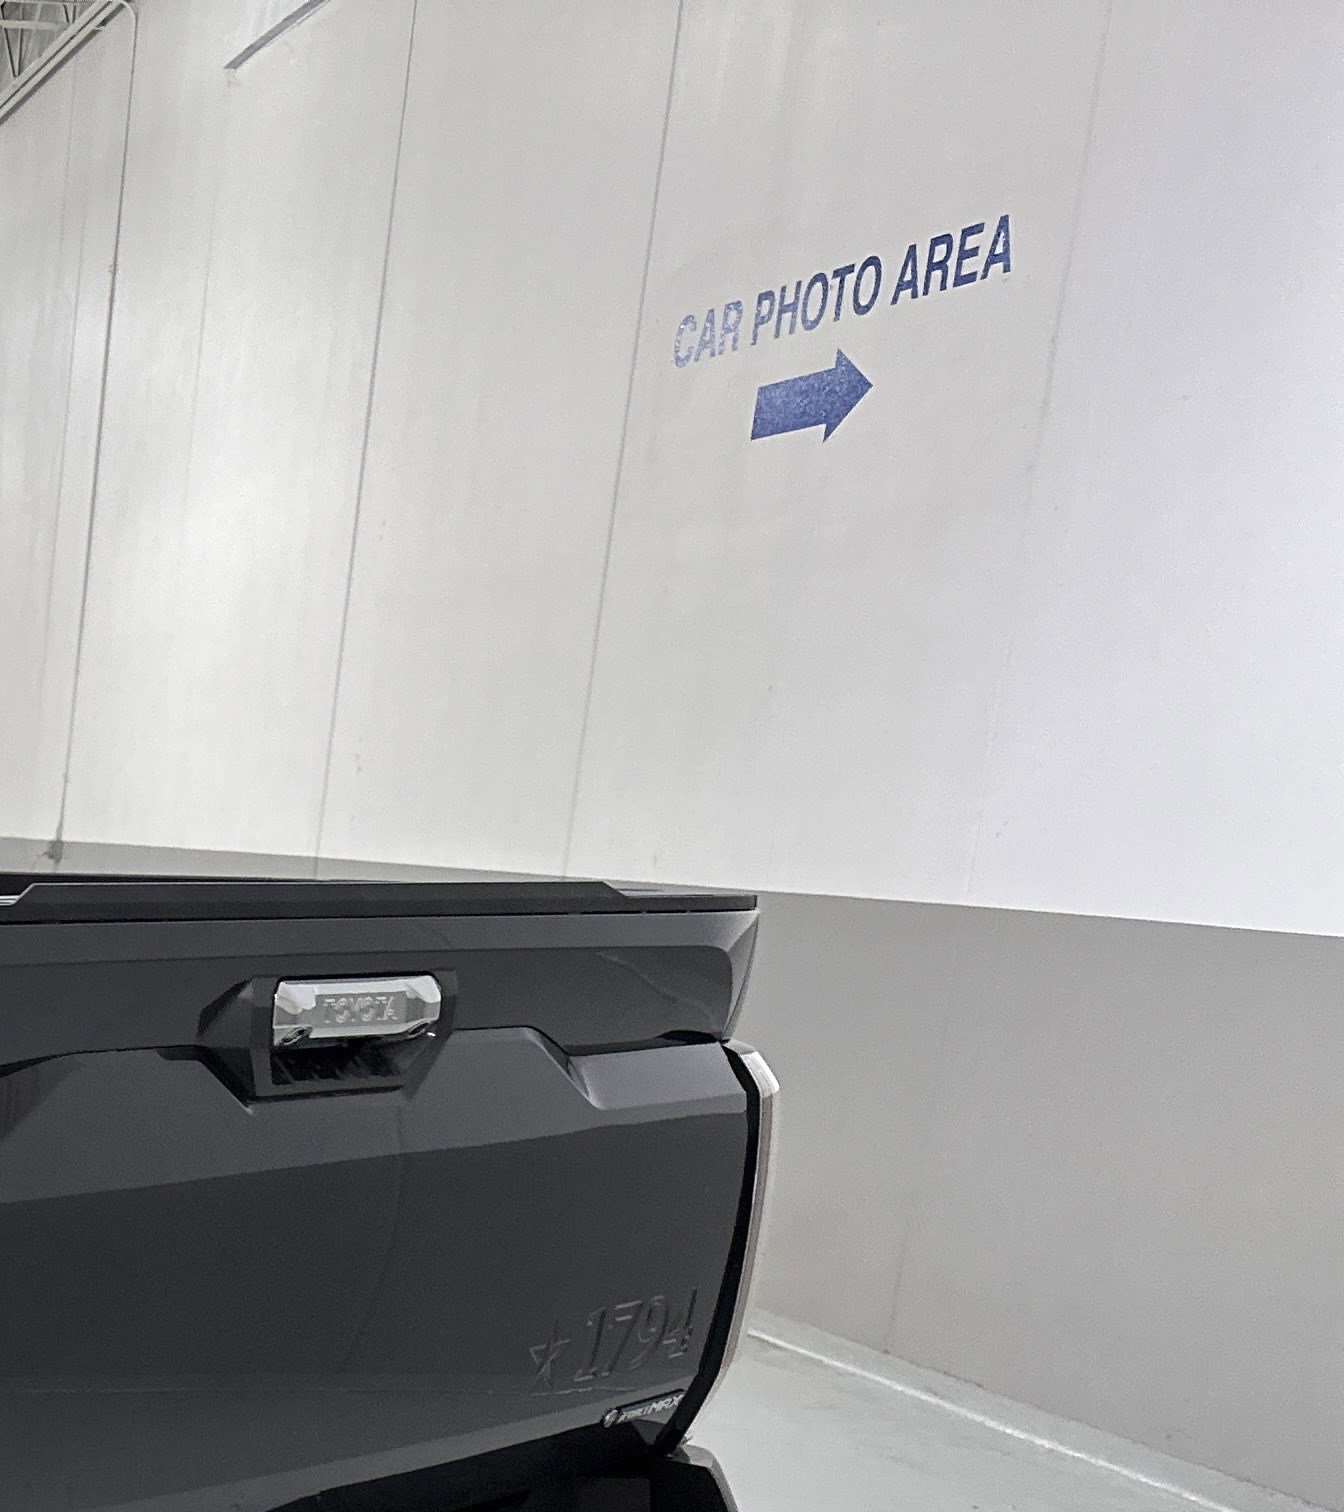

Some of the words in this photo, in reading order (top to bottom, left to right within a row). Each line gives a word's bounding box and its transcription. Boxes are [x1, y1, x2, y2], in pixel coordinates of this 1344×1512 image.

[673, 301, 743, 368] CAR
[750, 255, 883, 346] PHOTO
[890, 213, 1012, 305] AREA
